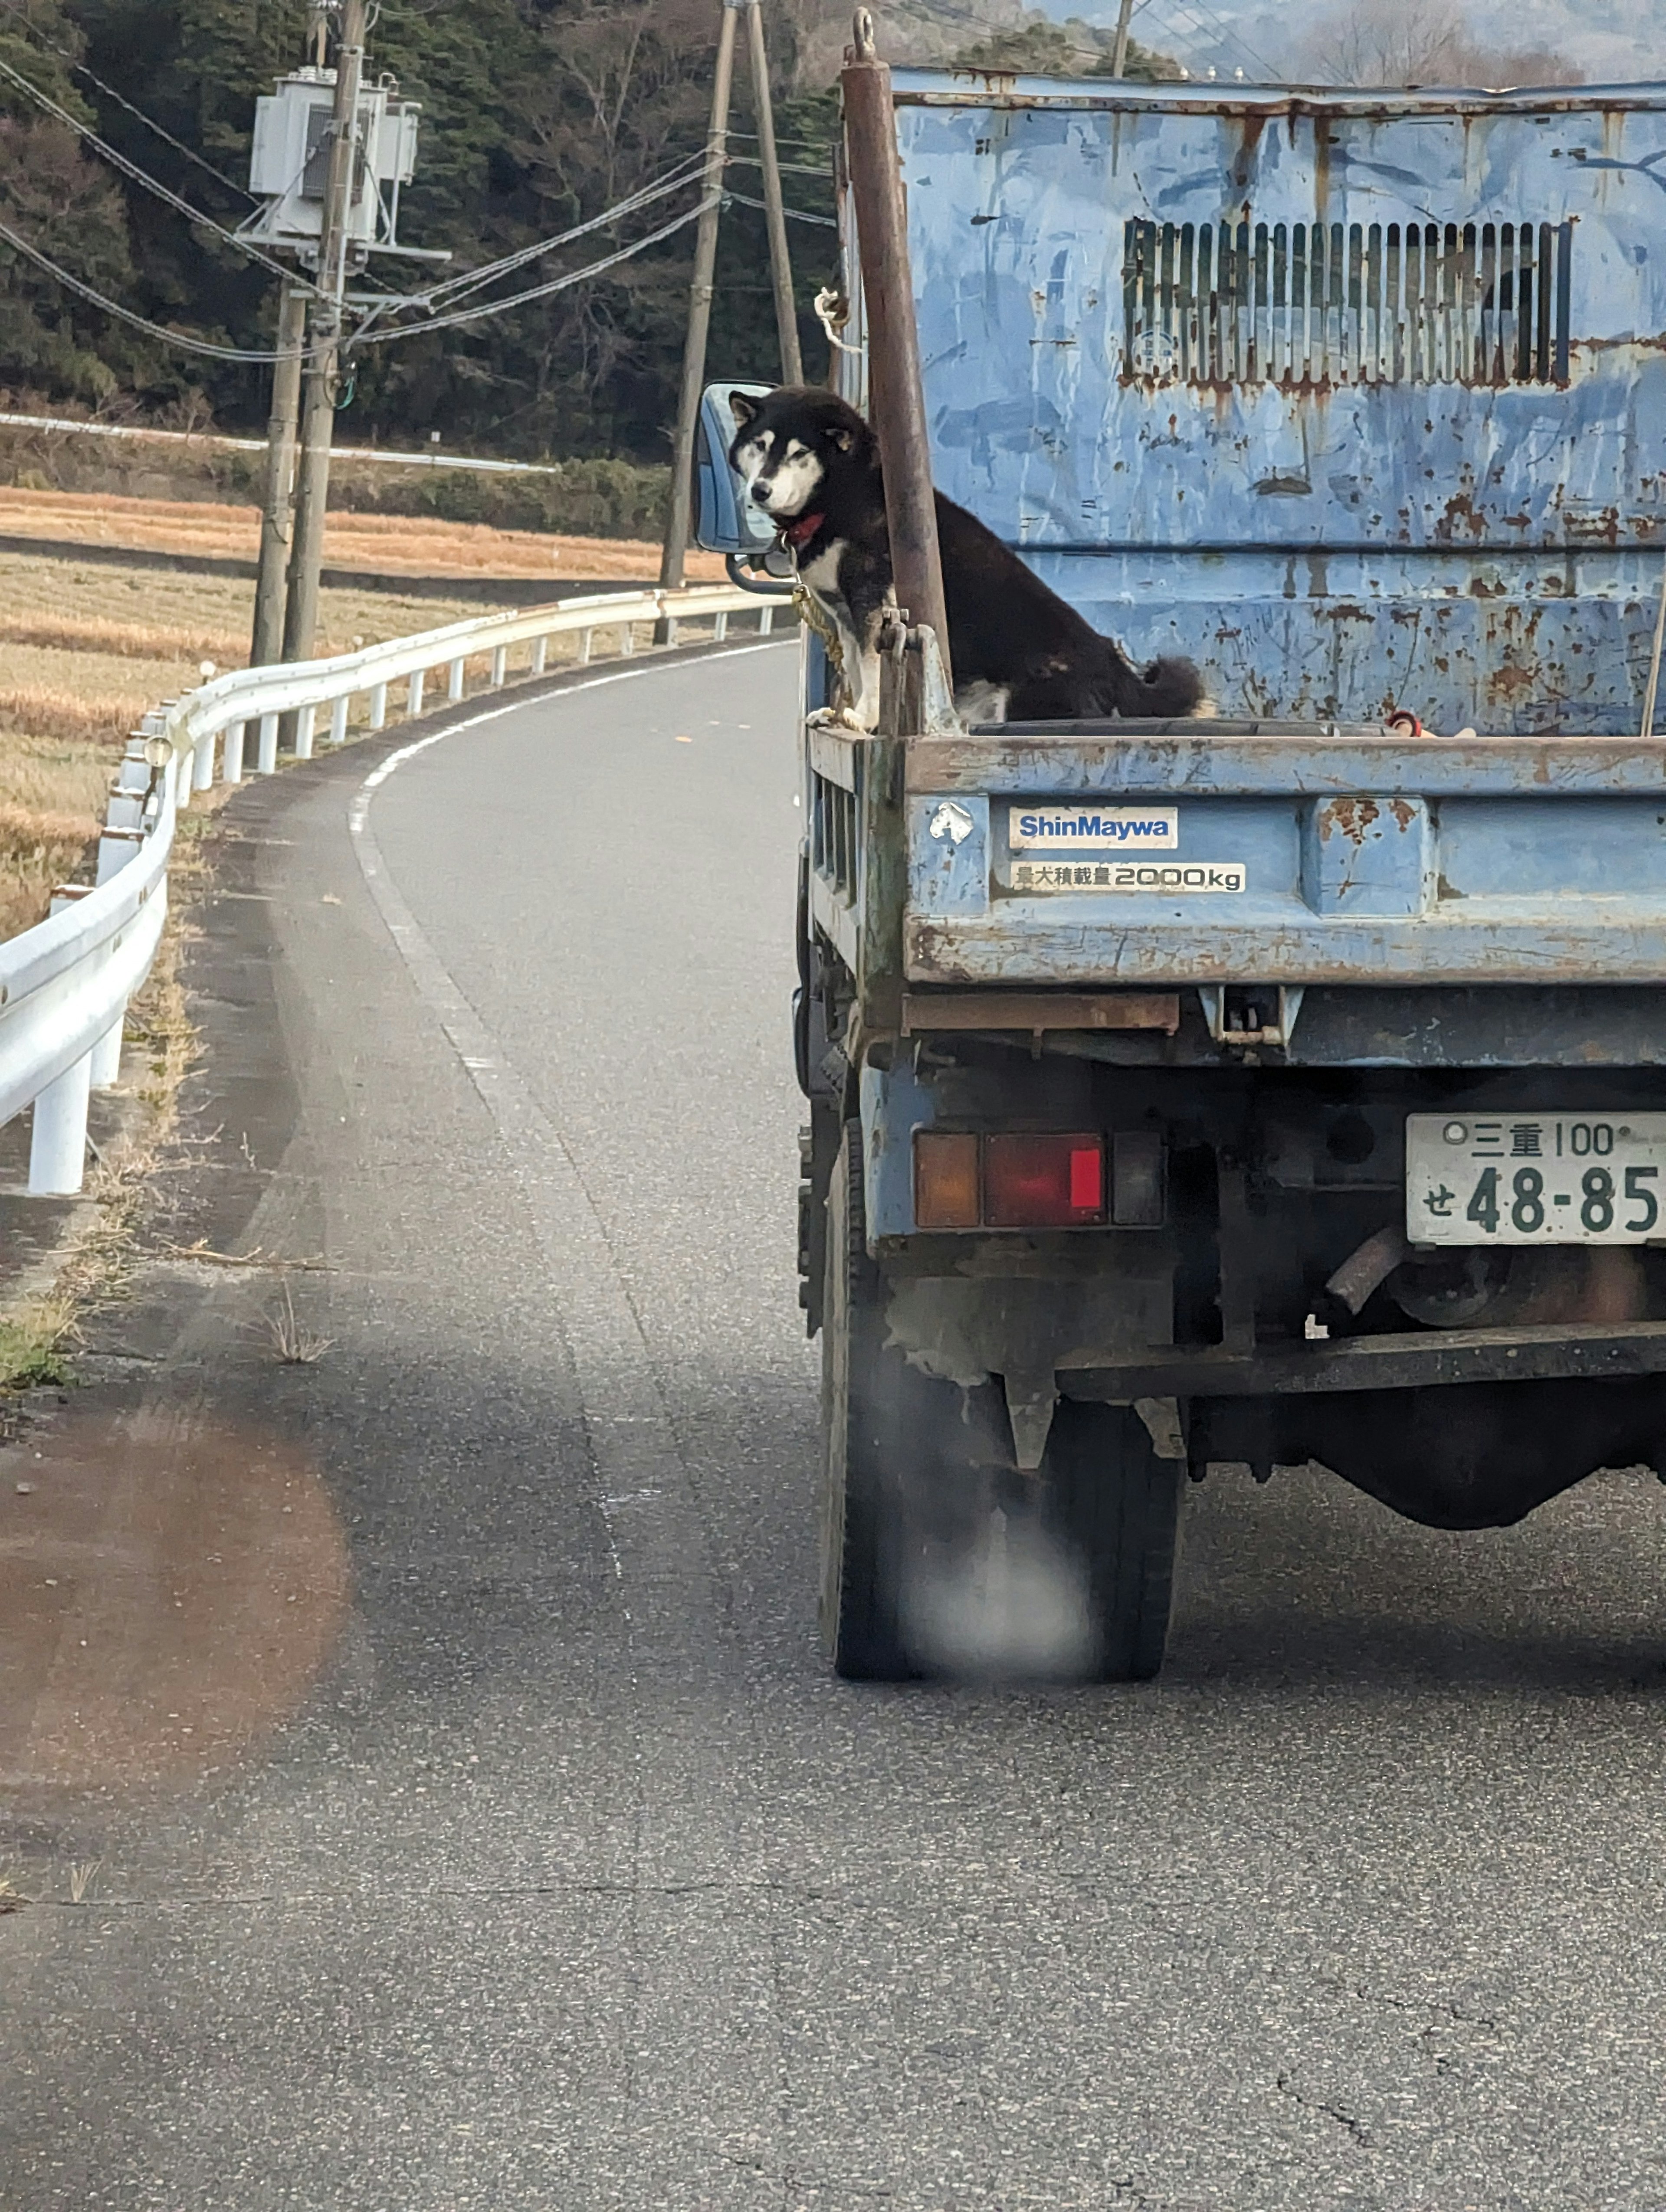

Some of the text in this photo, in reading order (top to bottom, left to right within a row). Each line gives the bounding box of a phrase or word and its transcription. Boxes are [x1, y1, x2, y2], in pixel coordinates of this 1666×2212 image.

[1020, 815, 1168, 841] ShinMaywa
[1115, 868, 1241, 891] 2000kg
[1471, 1122, 1614, 1157] 三重 100
[1423, 1167, 1658, 1233] せ 48-85
